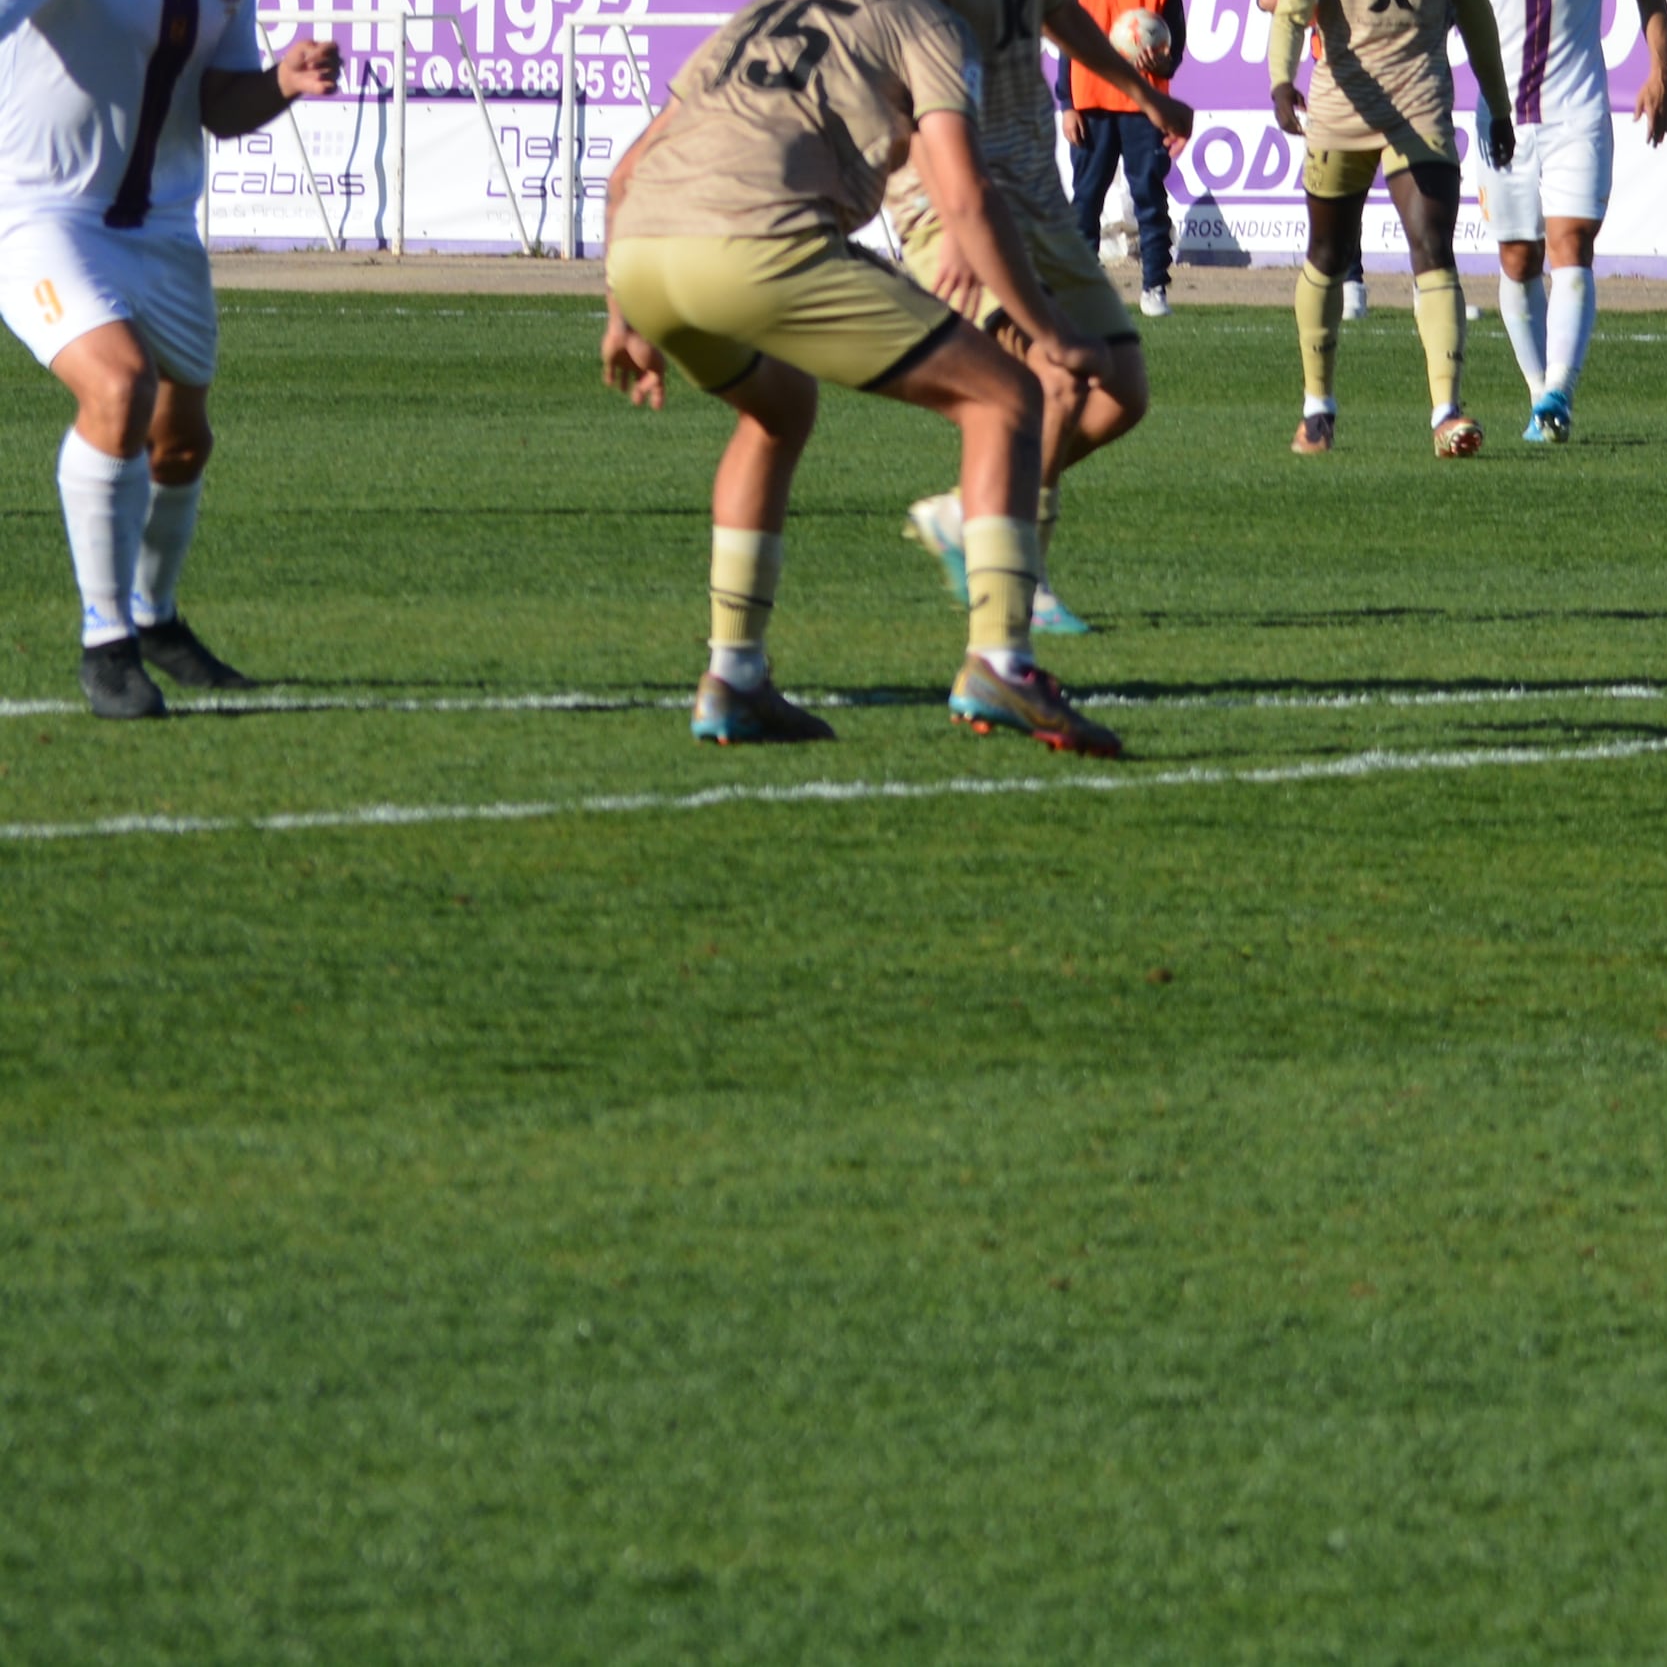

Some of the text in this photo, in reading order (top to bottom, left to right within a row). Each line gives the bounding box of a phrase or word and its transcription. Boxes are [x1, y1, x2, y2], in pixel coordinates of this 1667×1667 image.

[457, 58, 515, 98] 953
[520, 60, 559, 99] 88
[611, 61, 651, 102] 95
[211, 163, 366, 197] cabias
[1228, 218, 1307, 239] INDUSTR
[33, 277, 65, 326] 9
